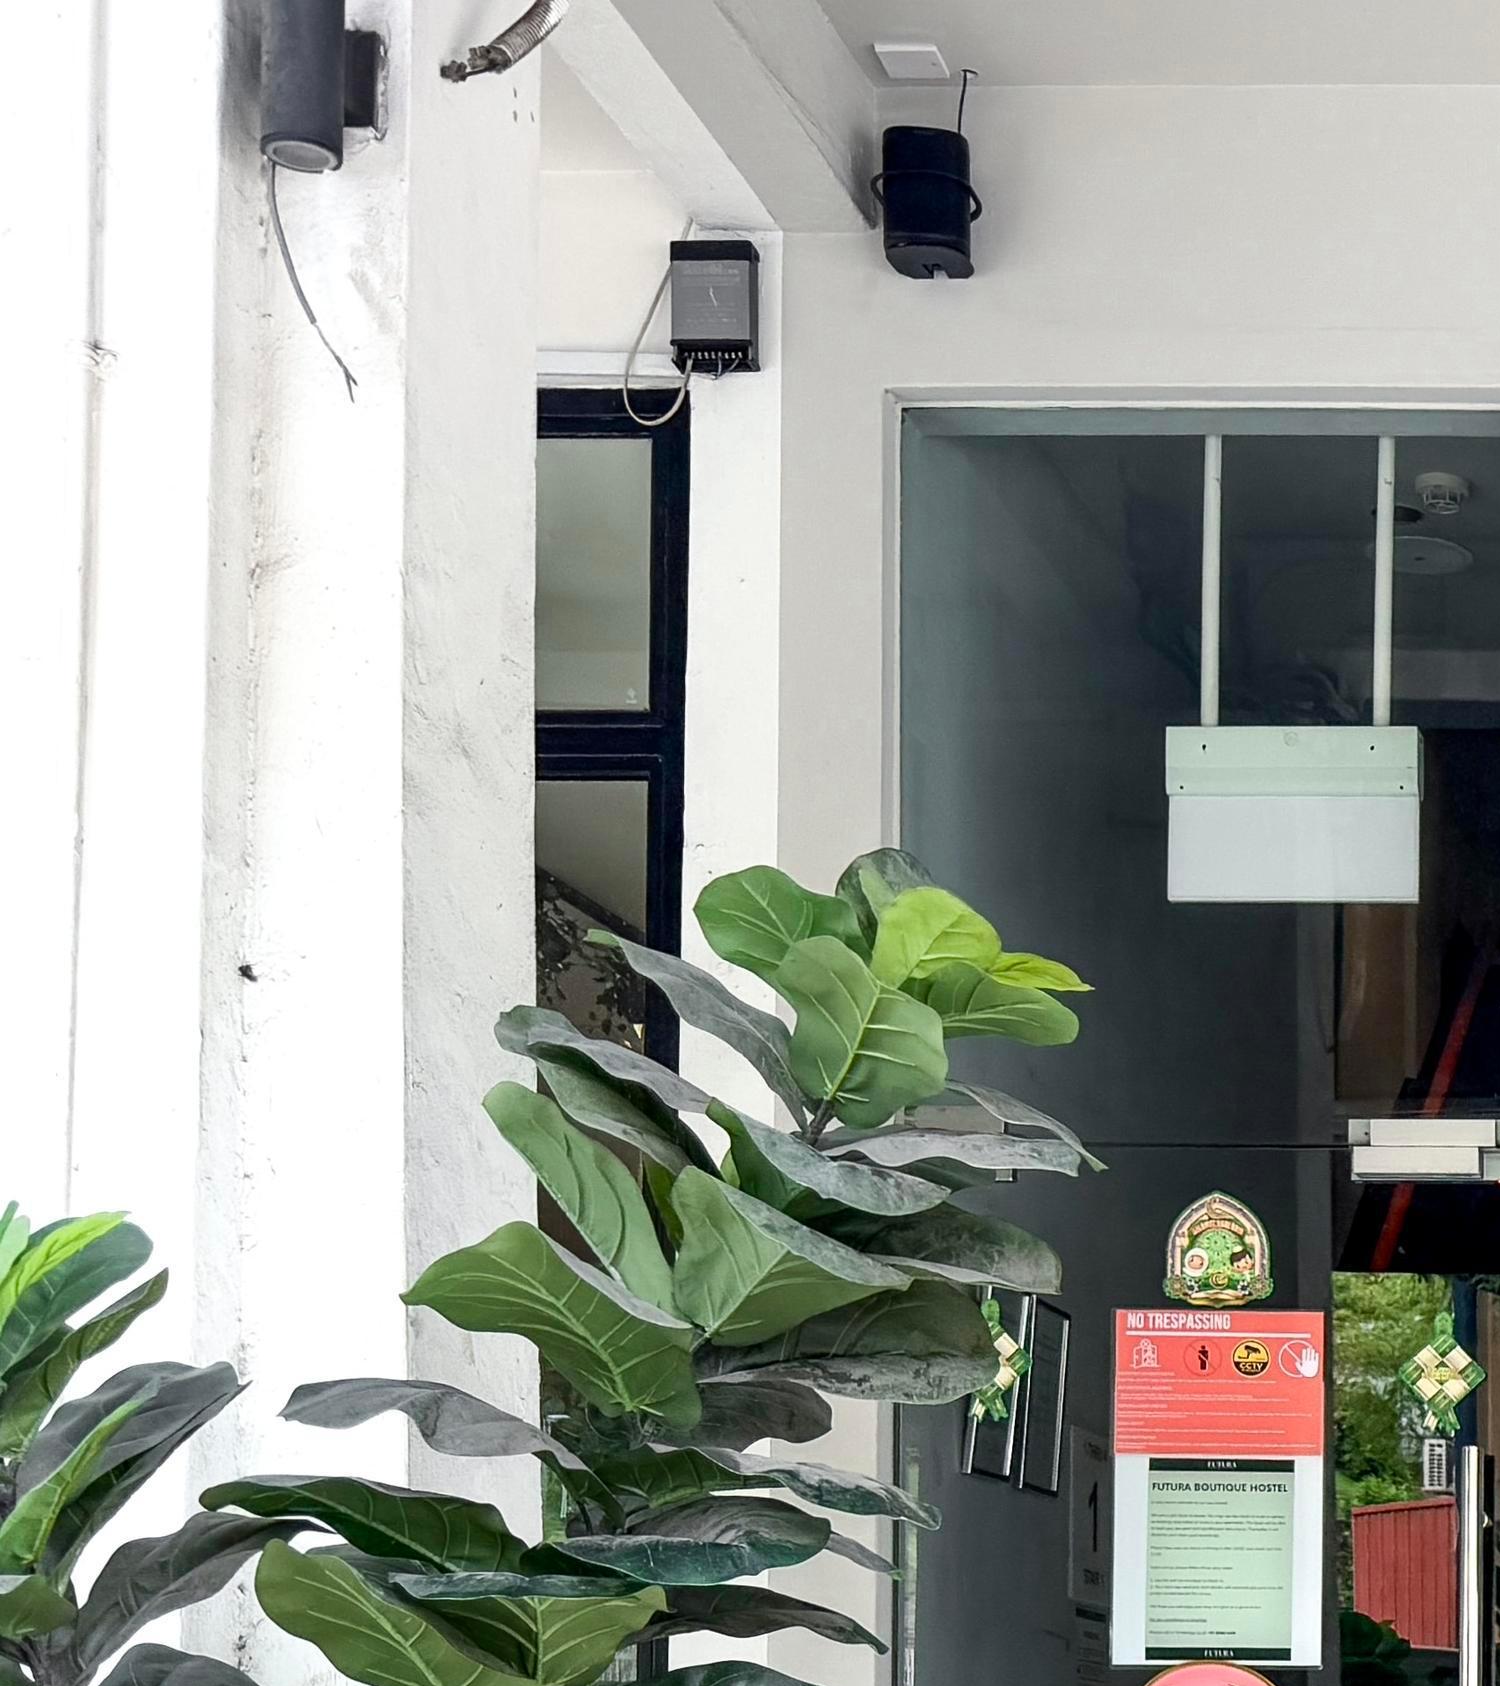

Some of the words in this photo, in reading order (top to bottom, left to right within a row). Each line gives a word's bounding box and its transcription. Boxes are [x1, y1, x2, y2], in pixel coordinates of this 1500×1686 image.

[1127, 1312, 1144, 1329] NO
[1147, 1313, 1231, 1330] TRESPASSING
[1151, 1482, 1192, 1492] FUTURA
[1194, 1483, 1247, 1493] BOUTIQUE
[1250, 1483, 1288, 1493] HOSTEL
